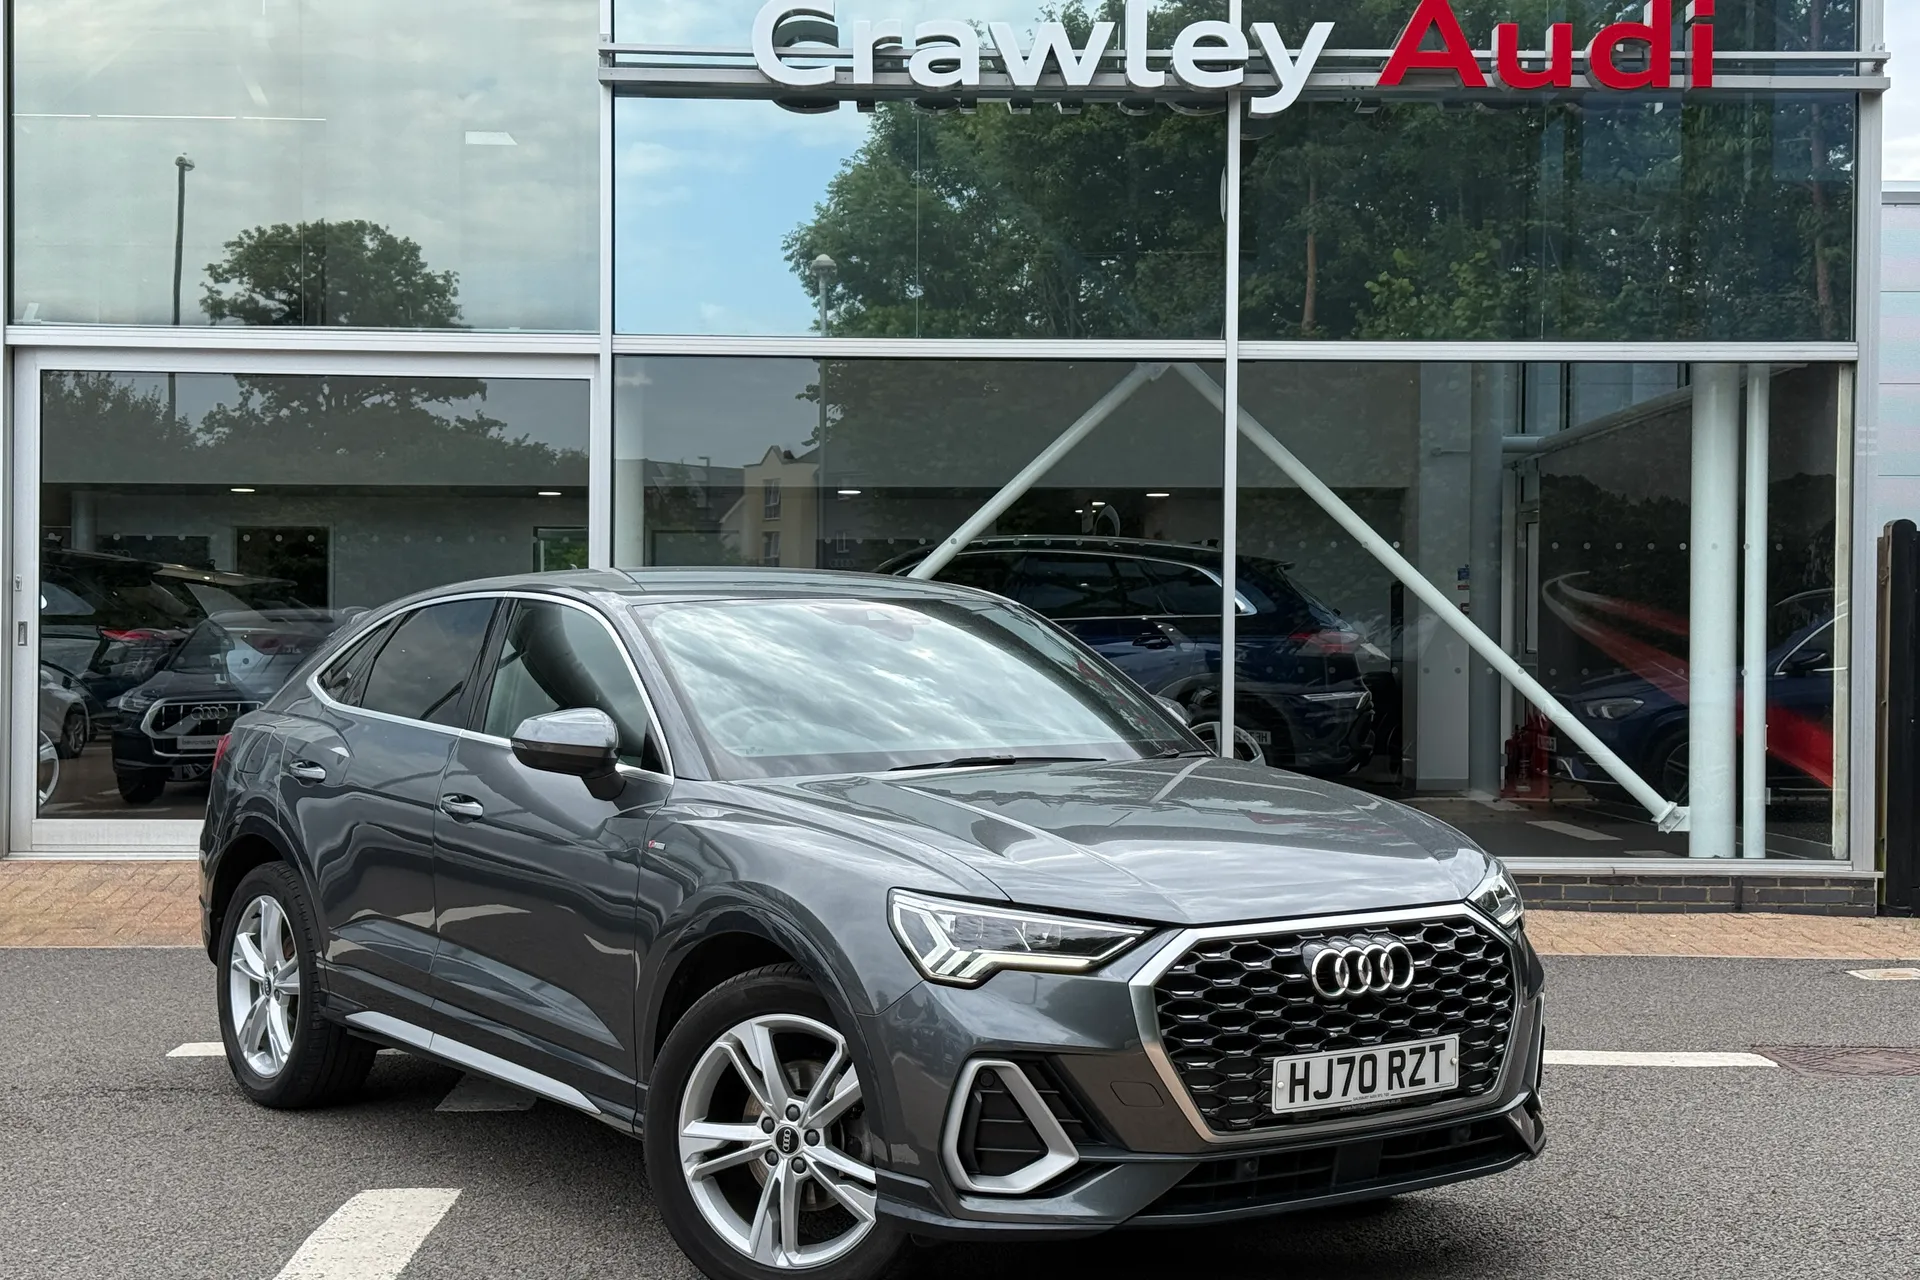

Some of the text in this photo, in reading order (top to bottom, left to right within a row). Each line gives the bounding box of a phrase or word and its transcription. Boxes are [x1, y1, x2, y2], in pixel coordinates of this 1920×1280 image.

[752, 0, 1716, 118] Crawley Audi
[1288, 1043, 1446, 1104] HJ70 RZT
